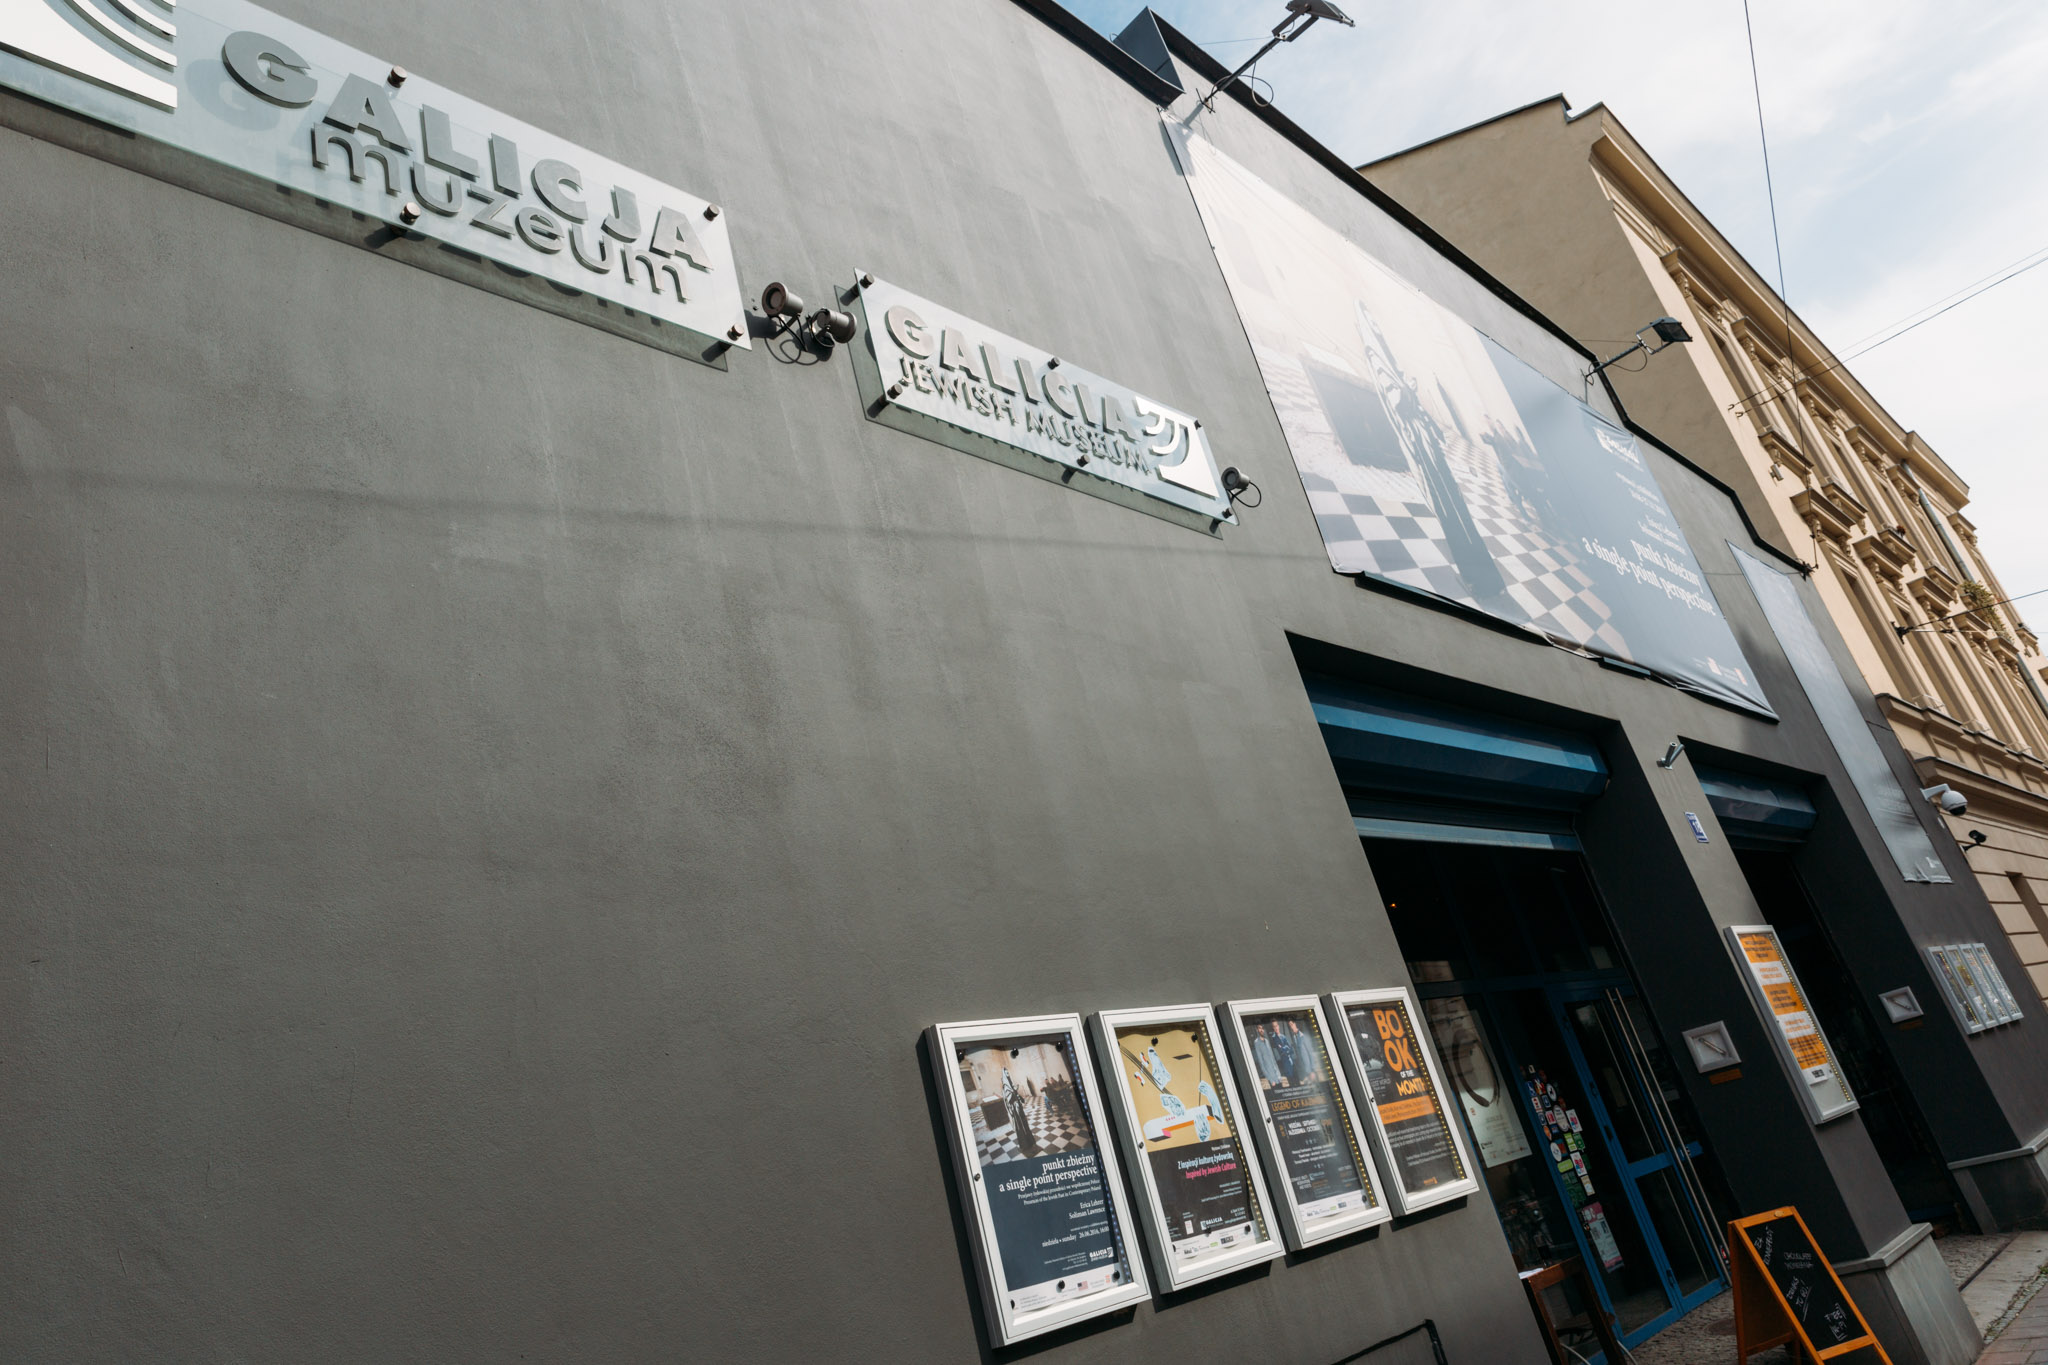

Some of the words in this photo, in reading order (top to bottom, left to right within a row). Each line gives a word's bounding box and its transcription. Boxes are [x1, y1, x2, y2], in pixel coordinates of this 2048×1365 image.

[222, 31, 712, 271] GALICJA
[311, 122, 692, 303] muzeum
[885, 305, 1141, 441] GALICIA
[899, 355, 1020, 425] JEWISH
[1026, 405, 1151, 475] MUSEUM
[1582, 537, 1594, 554] a
[1592, 538, 1631, 576] single
[1628, 560, 1662, 589] point
[1659, 577, 1716, 616] perspective
[1396, 1077, 1427, 1096] MONTH
[998, 1183, 1005, 1192] a
[1006, 1176, 1032, 1191] single
[1032, 1172, 1054, 1188] point
[1055, 1165, 1098, 1184] perspective
[1042, 1157, 1065, 1174] punkt
[1066, 1154, 1095, 1167] zbieżny
[1185, 1168, 1201, 1180] Inspired
[1207, 1164, 1221, 1174] Jewish
[1221, 1162, 1237, 1171] Culture
[1080, 1201, 1091, 1209] Erica
